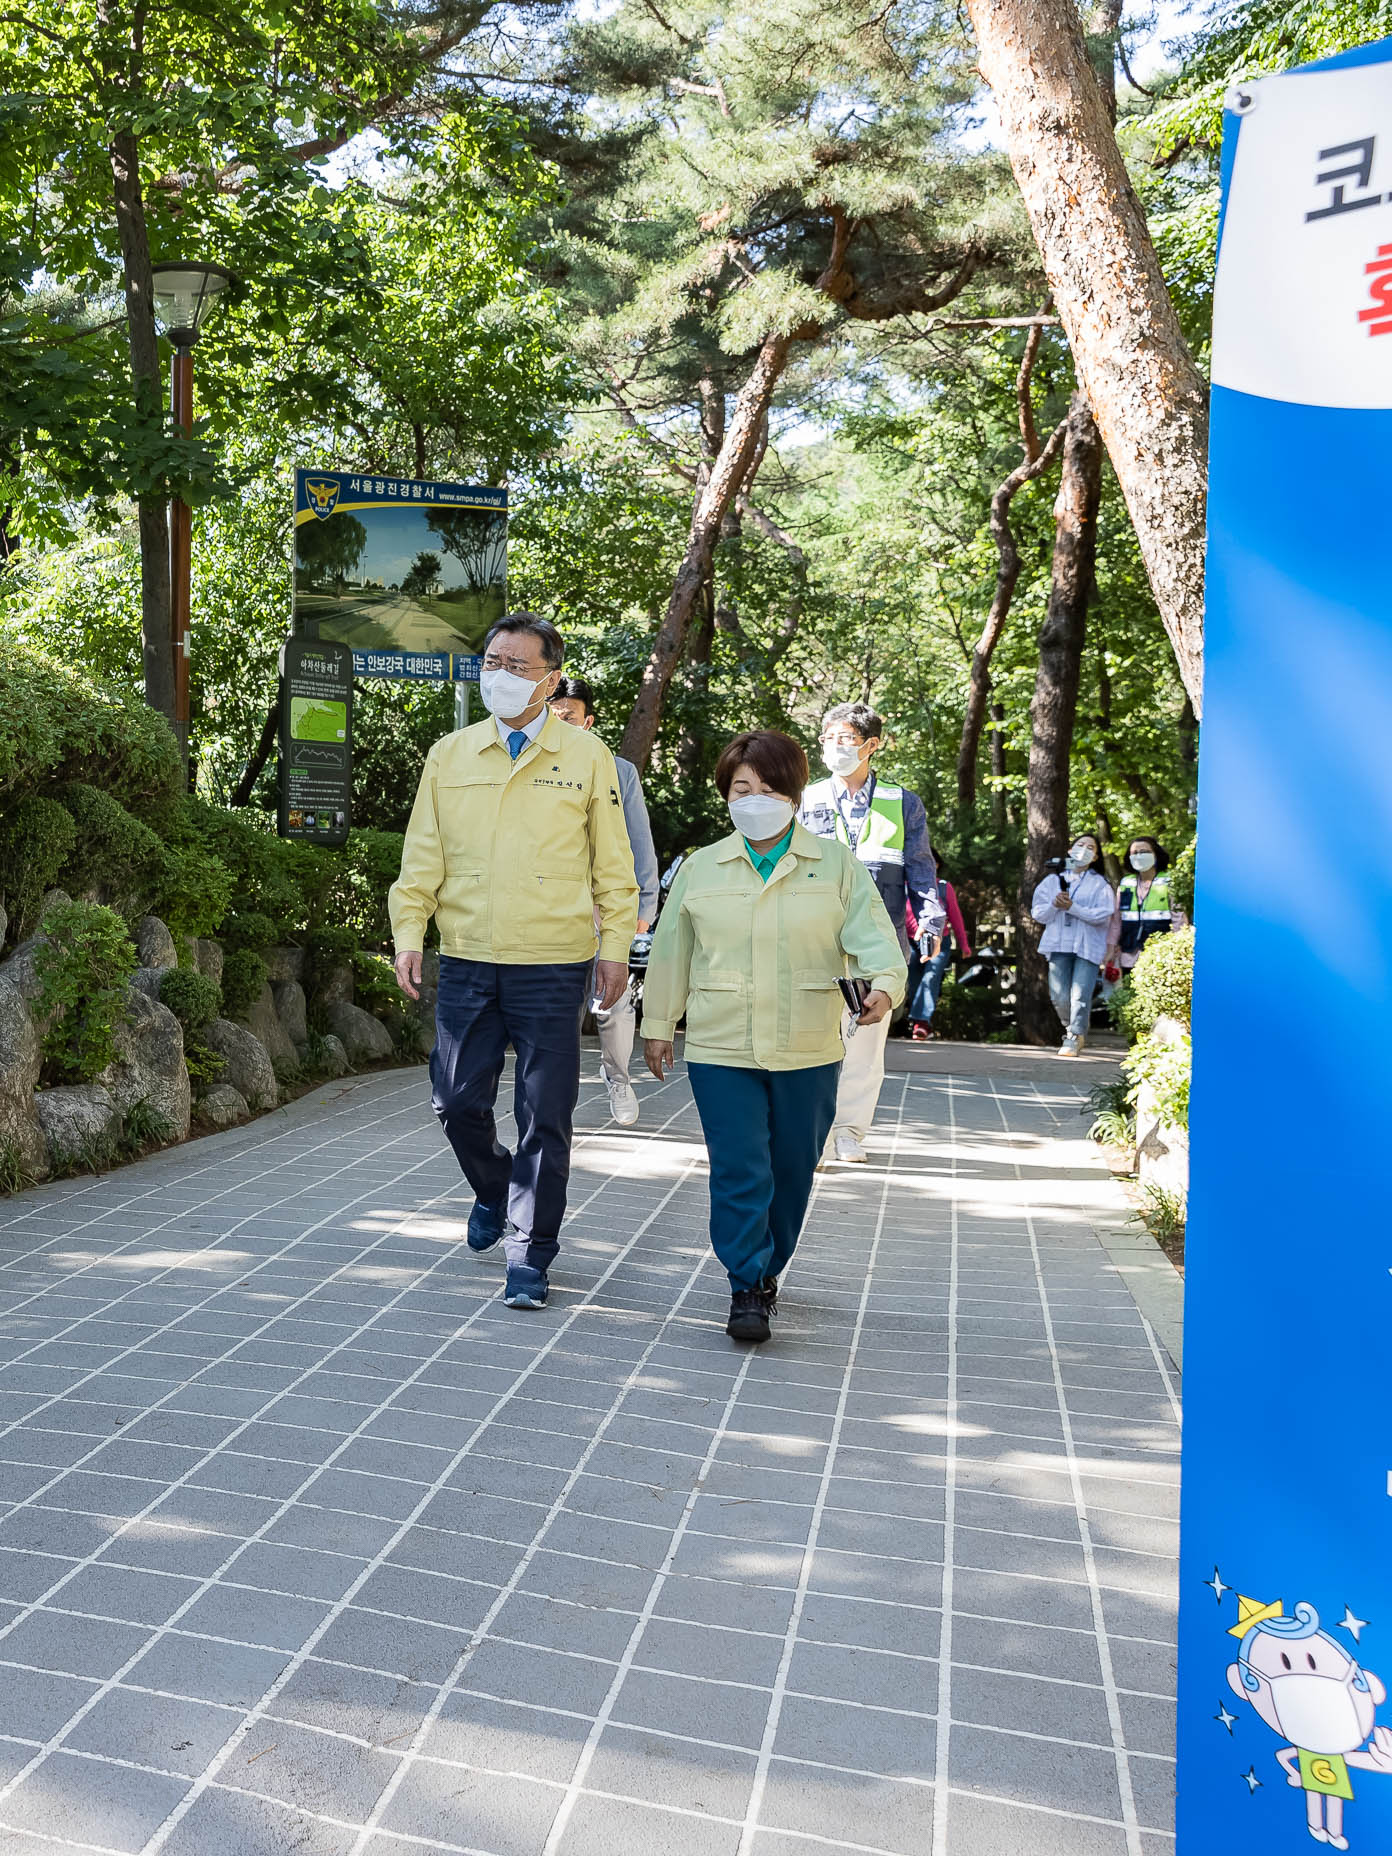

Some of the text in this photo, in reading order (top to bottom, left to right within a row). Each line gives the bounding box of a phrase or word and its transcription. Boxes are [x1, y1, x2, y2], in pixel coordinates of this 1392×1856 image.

[1304, 135, 1392, 223] 코
[350, 478, 435, 500] 서울광진경찰서
[352, 654, 443, 675] 는 안보강국 대한민국
